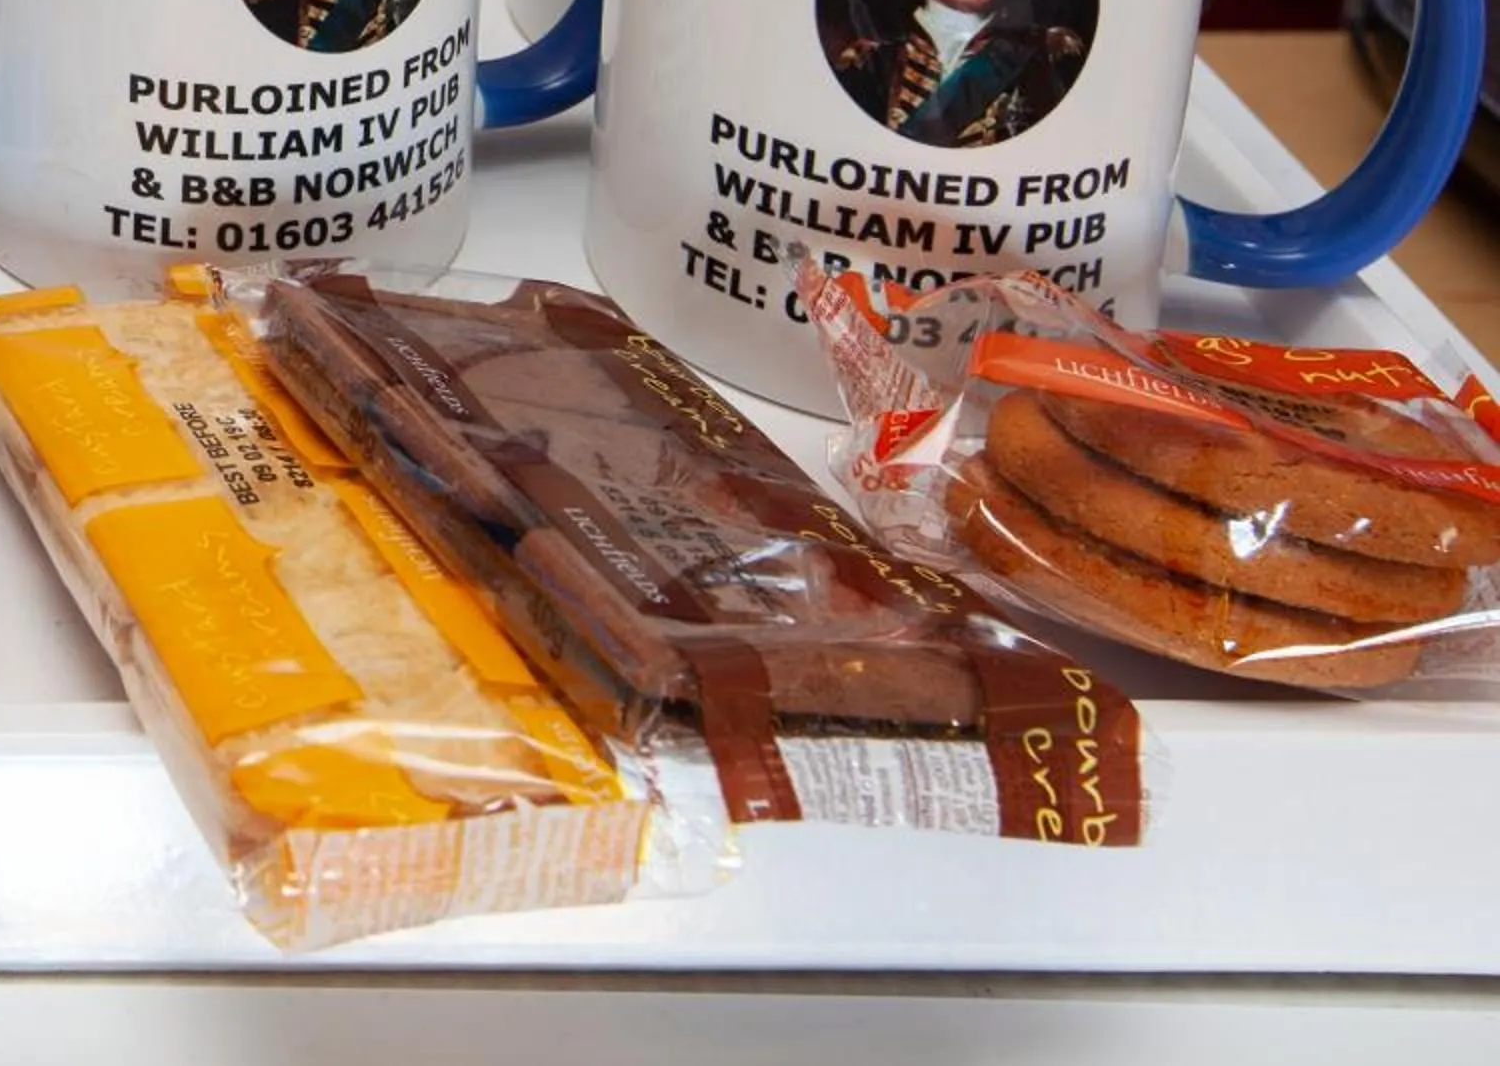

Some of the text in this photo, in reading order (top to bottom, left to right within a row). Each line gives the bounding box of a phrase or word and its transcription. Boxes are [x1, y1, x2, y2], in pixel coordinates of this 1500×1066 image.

[128, 16, 471, 116] PURLOINED FROM
[130, 115, 459, 208] & B&B NORWICH
[134, 73, 461, 162] WILLIAM IV PUB
[709, 112, 1132, 208] PURLOINED FROM
[103, 149, 465, 254] TEL: 01603 441526
[705, 210, 738, 250] &
[713, 162, 1108, 257] WILLIAM IV PUB
[680, 241, 767, 310] TEL:
[172, 401, 261, 507] BEST BEFORE
[237, 442, 262, 463] 02
[251, 462, 277, 484] 09
[1021, 727, 1064, 845] cre
[1061, 666, 1118, 848] bourb
